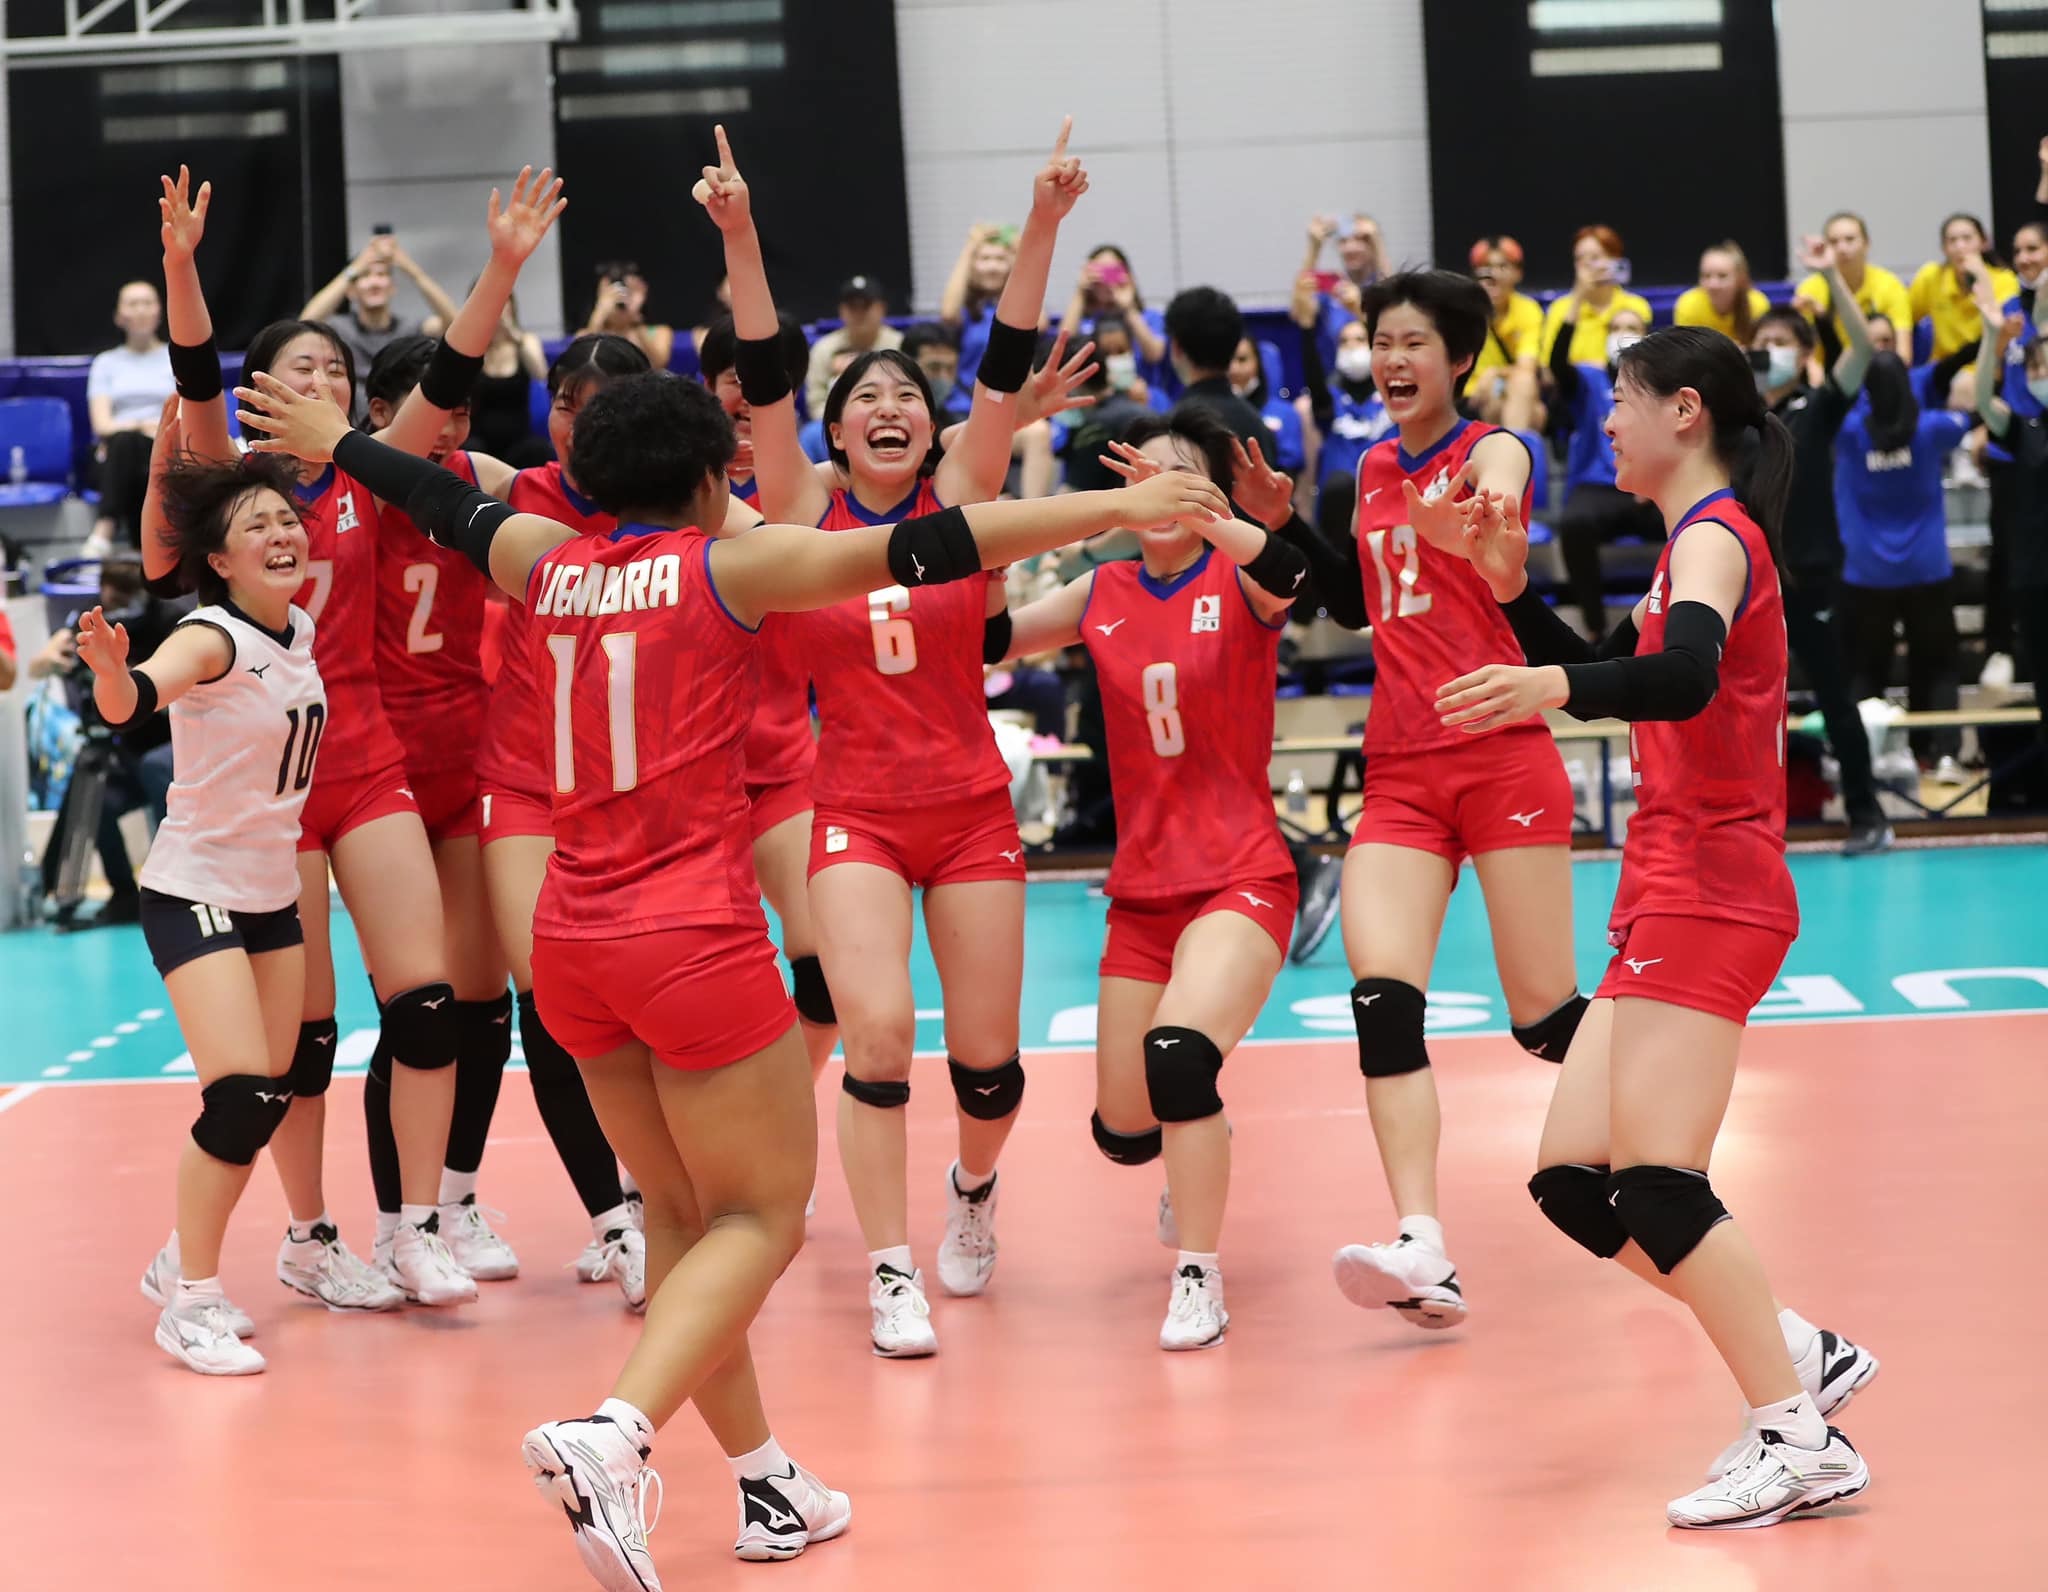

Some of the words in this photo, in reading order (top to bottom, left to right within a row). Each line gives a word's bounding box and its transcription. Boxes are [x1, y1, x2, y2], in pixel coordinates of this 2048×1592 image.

[306, 560, 334, 624] 7
[403, 563, 444, 653] 2
[1366, 524, 1433, 622] 12
[867, 584, 918, 675] 6
[275, 702, 324, 796] 10
[546, 632, 638, 793] 11
[1142, 661, 1185, 757] 8
[826, 825, 849, 854] 6
[190, 904, 233, 938] 10
